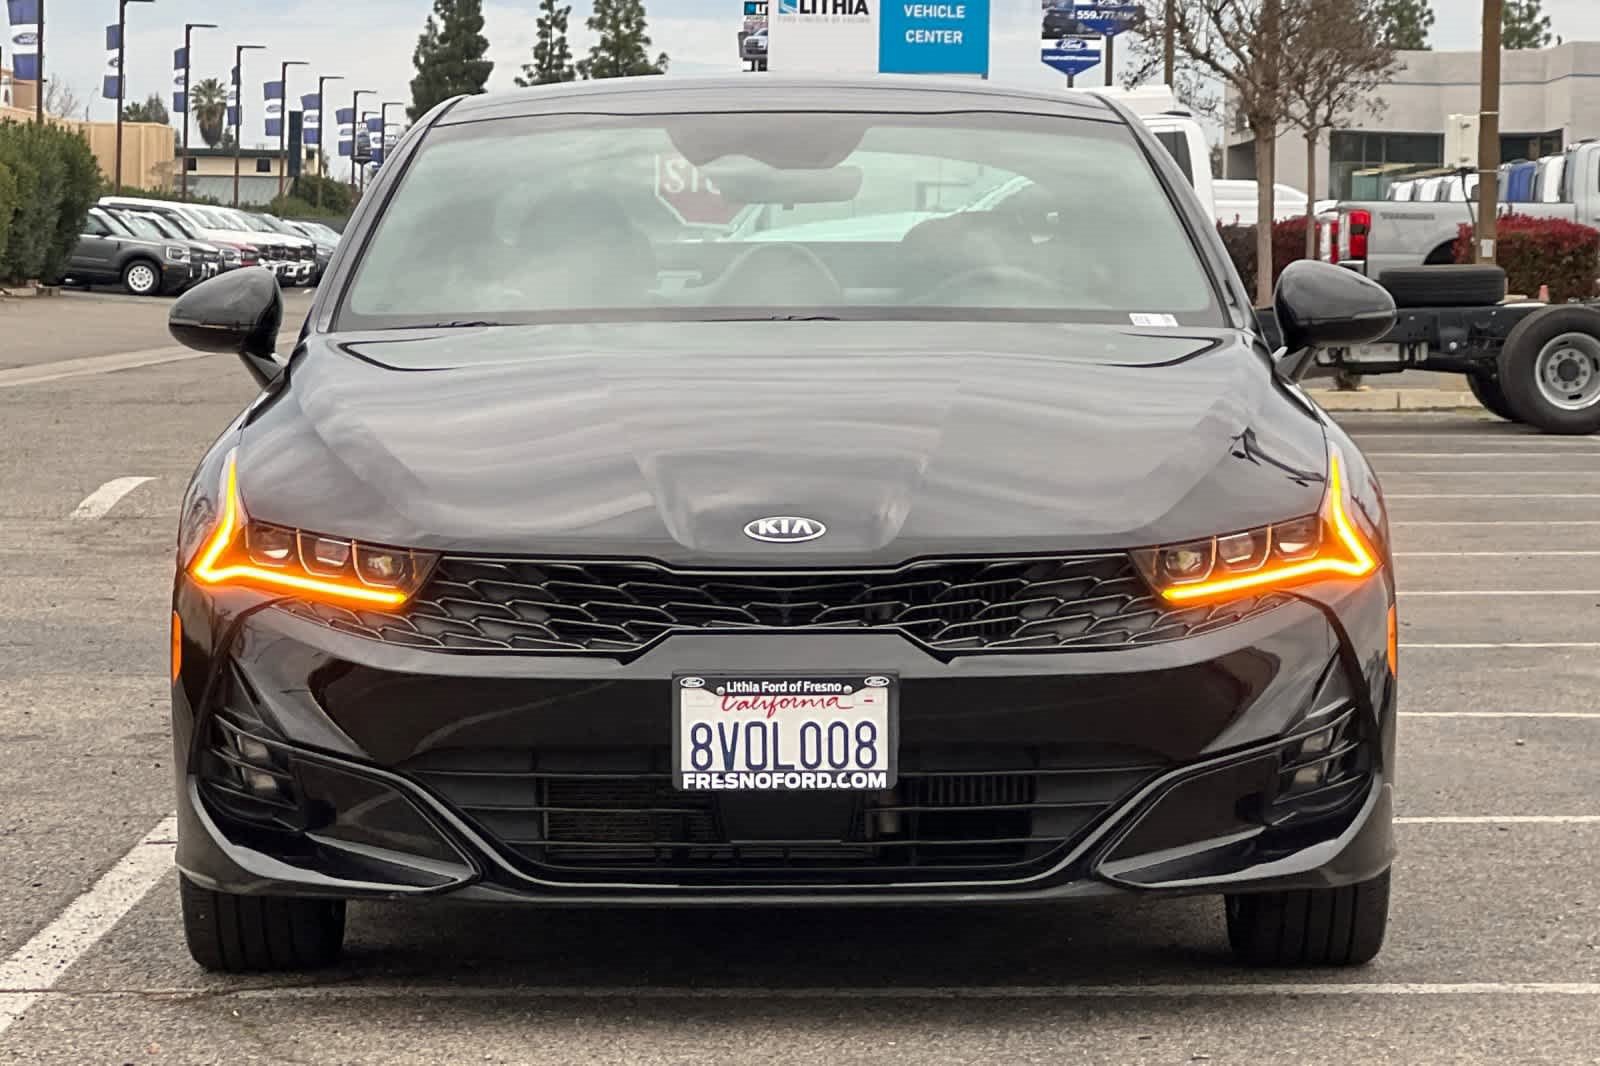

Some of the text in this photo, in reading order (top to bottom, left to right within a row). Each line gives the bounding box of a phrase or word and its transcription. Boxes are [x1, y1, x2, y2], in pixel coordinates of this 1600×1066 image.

[798, 0, 869, 15] LITHIA
[903, 4, 966, 19] VEHICLE
[905, 29, 963, 44] CENTER
[758, 519, 814, 534] KIA
[726, 681, 842, 693] Lithia Ford of Fresno
[721, 694, 853, 719] California
[682, 772, 887, 790] FRESNOFORD.COM
